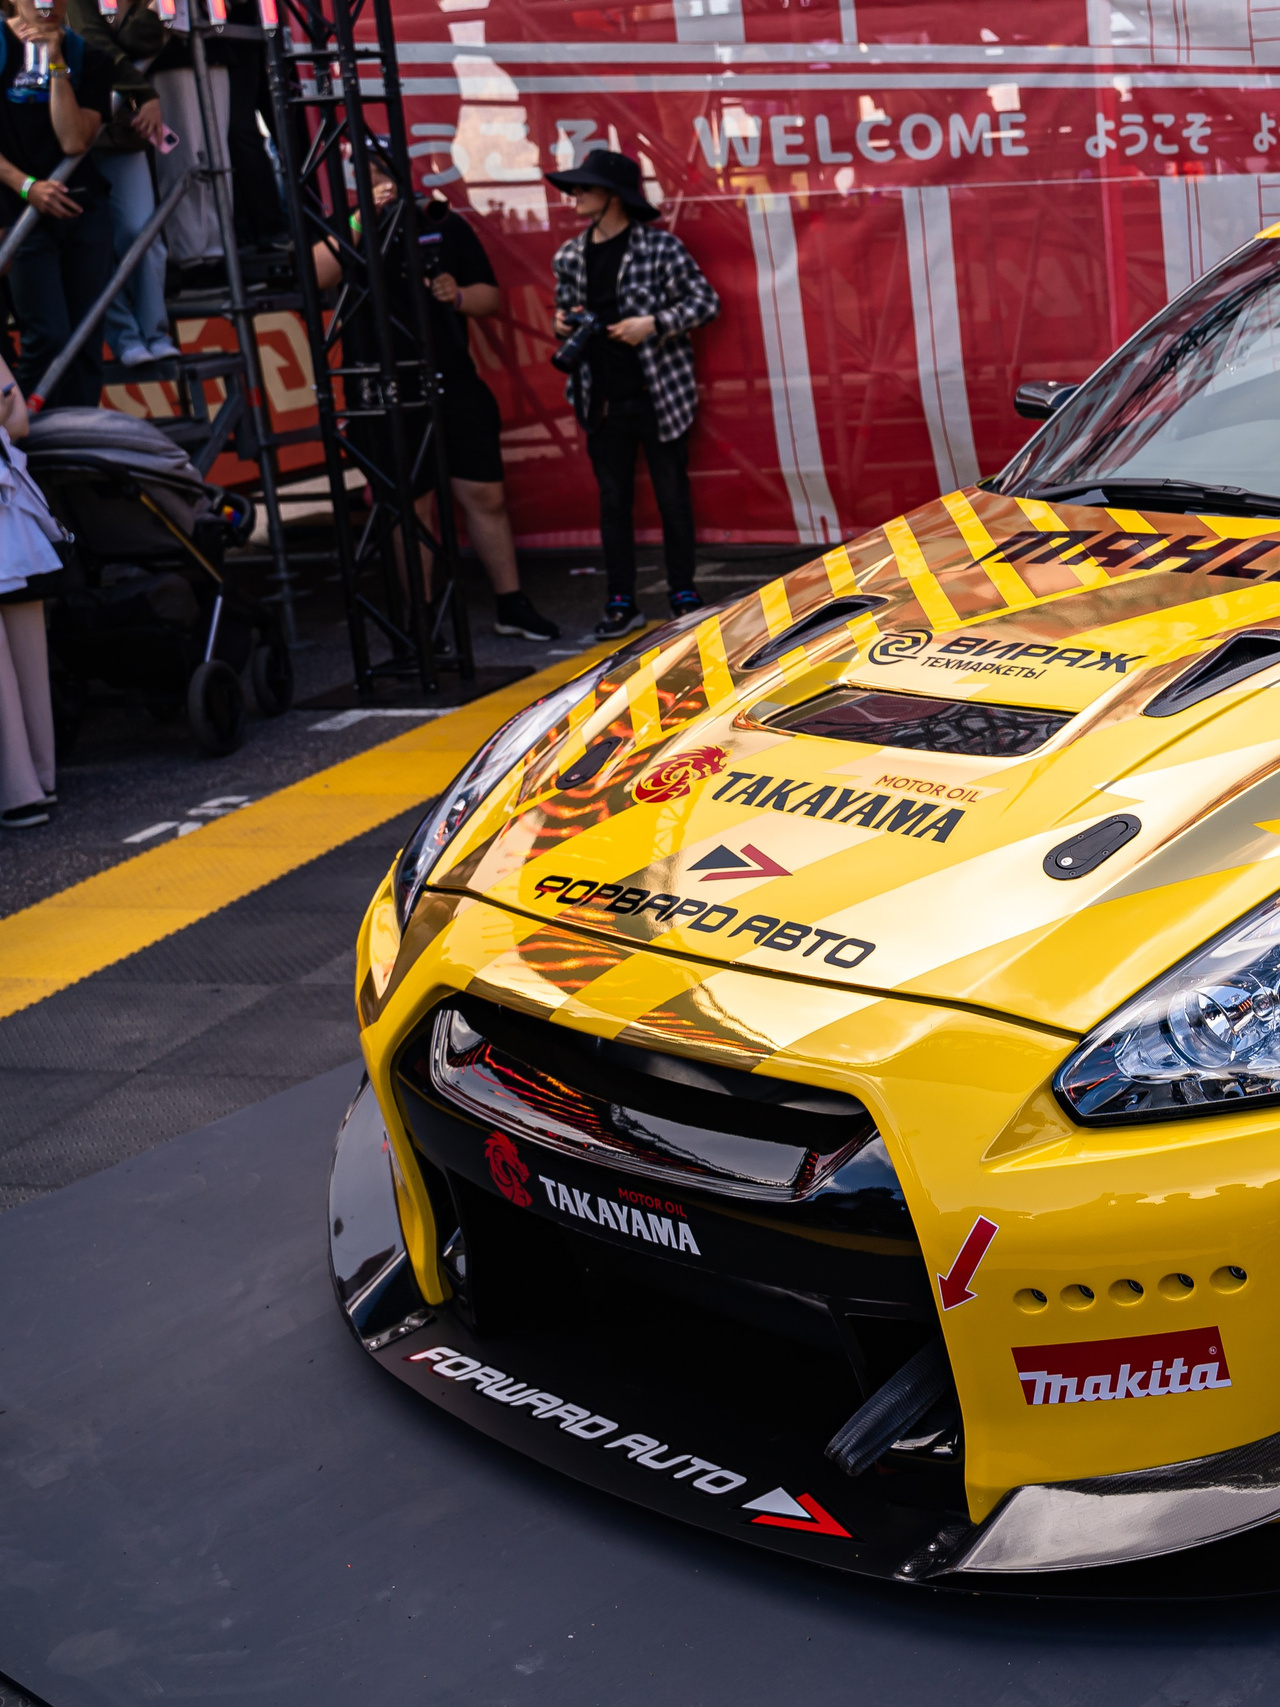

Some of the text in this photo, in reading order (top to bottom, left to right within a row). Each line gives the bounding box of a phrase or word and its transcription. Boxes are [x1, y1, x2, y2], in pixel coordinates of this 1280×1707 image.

[693, 113, 1030, 168] WELCOME
[1085, 113, 1211, 158] ようこそ
[921, 656, 1048, 680] ТЕХМАРКЕТЫ
[937, 636, 1149, 673] ВИРАЖ
[711, 771, 966, 843] TAKAYAMA
[877, 774, 982, 804] MOTOR OIL
[727, 914, 876, 969] АВТО
[538, 1174, 701, 1256] TAKAYAMA
[618, 1187, 687, 1218] MOTOR OIL
[409, 1346, 747, 1494] FORWARD AUTO
